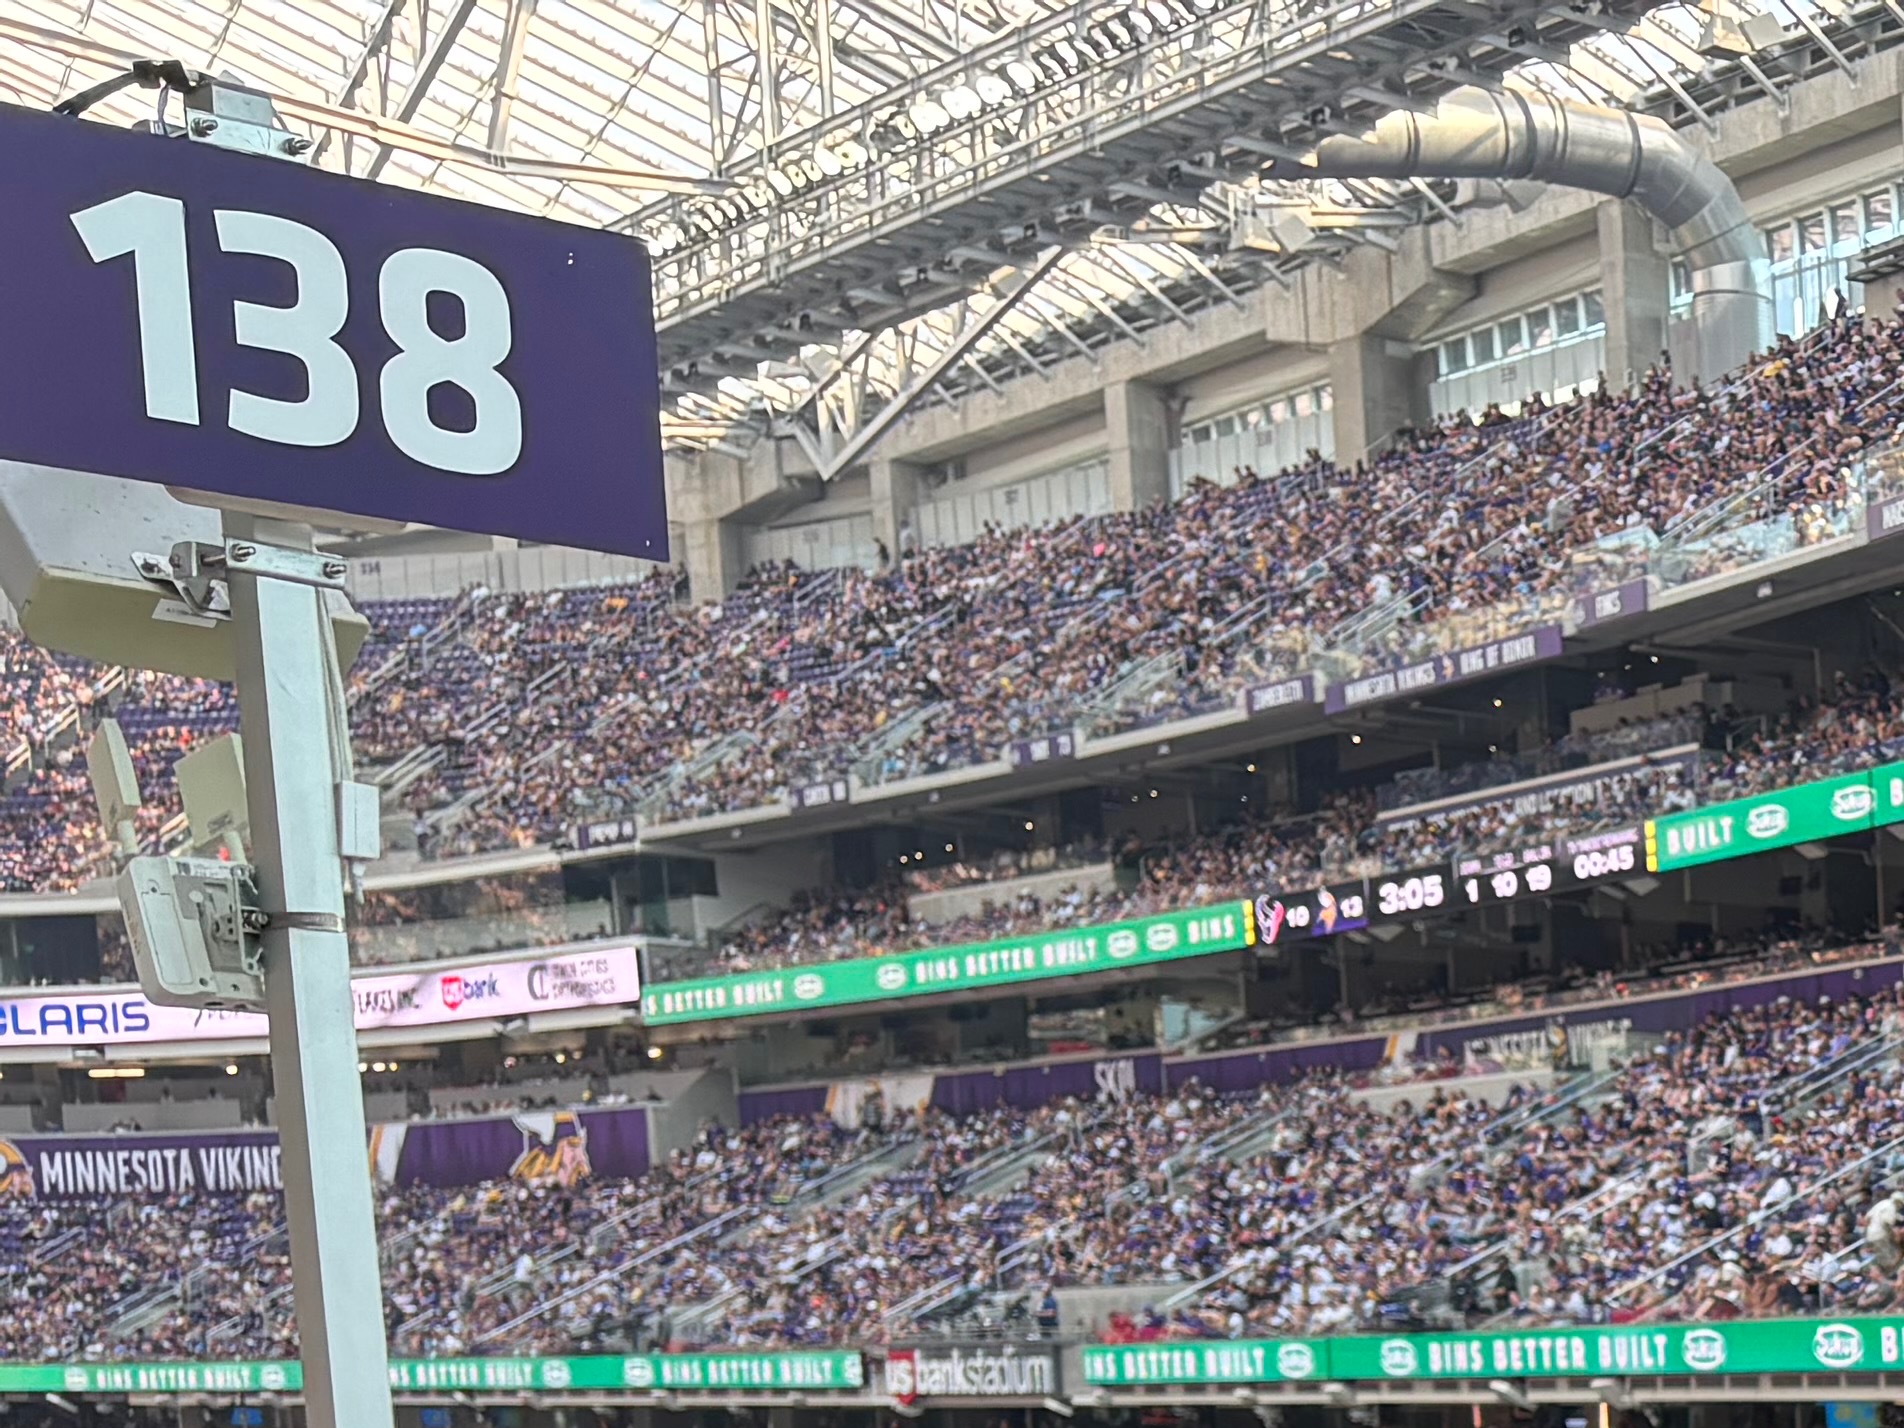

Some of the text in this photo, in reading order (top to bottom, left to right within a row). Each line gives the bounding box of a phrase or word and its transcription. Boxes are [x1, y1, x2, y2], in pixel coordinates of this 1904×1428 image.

[70, 189, 524, 477] 138
[1667, 817, 1732, 855] BUILT
[1573, 845, 1635, 880] 00:45
[1378, 875, 1444, 914] 3:05
[1465, 879, 1479, 903] 1
[1491, 871, 1518, 899] 10
[1286, 905, 1310, 929] 10
[0, 1000, 151, 1037] LARIS
[39, 1148, 195, 1195] MINNESOTA
[1429, 1341, 1483, 1373] BINS
[1494, 1337, 1585, 1371] BETTER
[1599, 1335, 1666, 1370] BUILT
